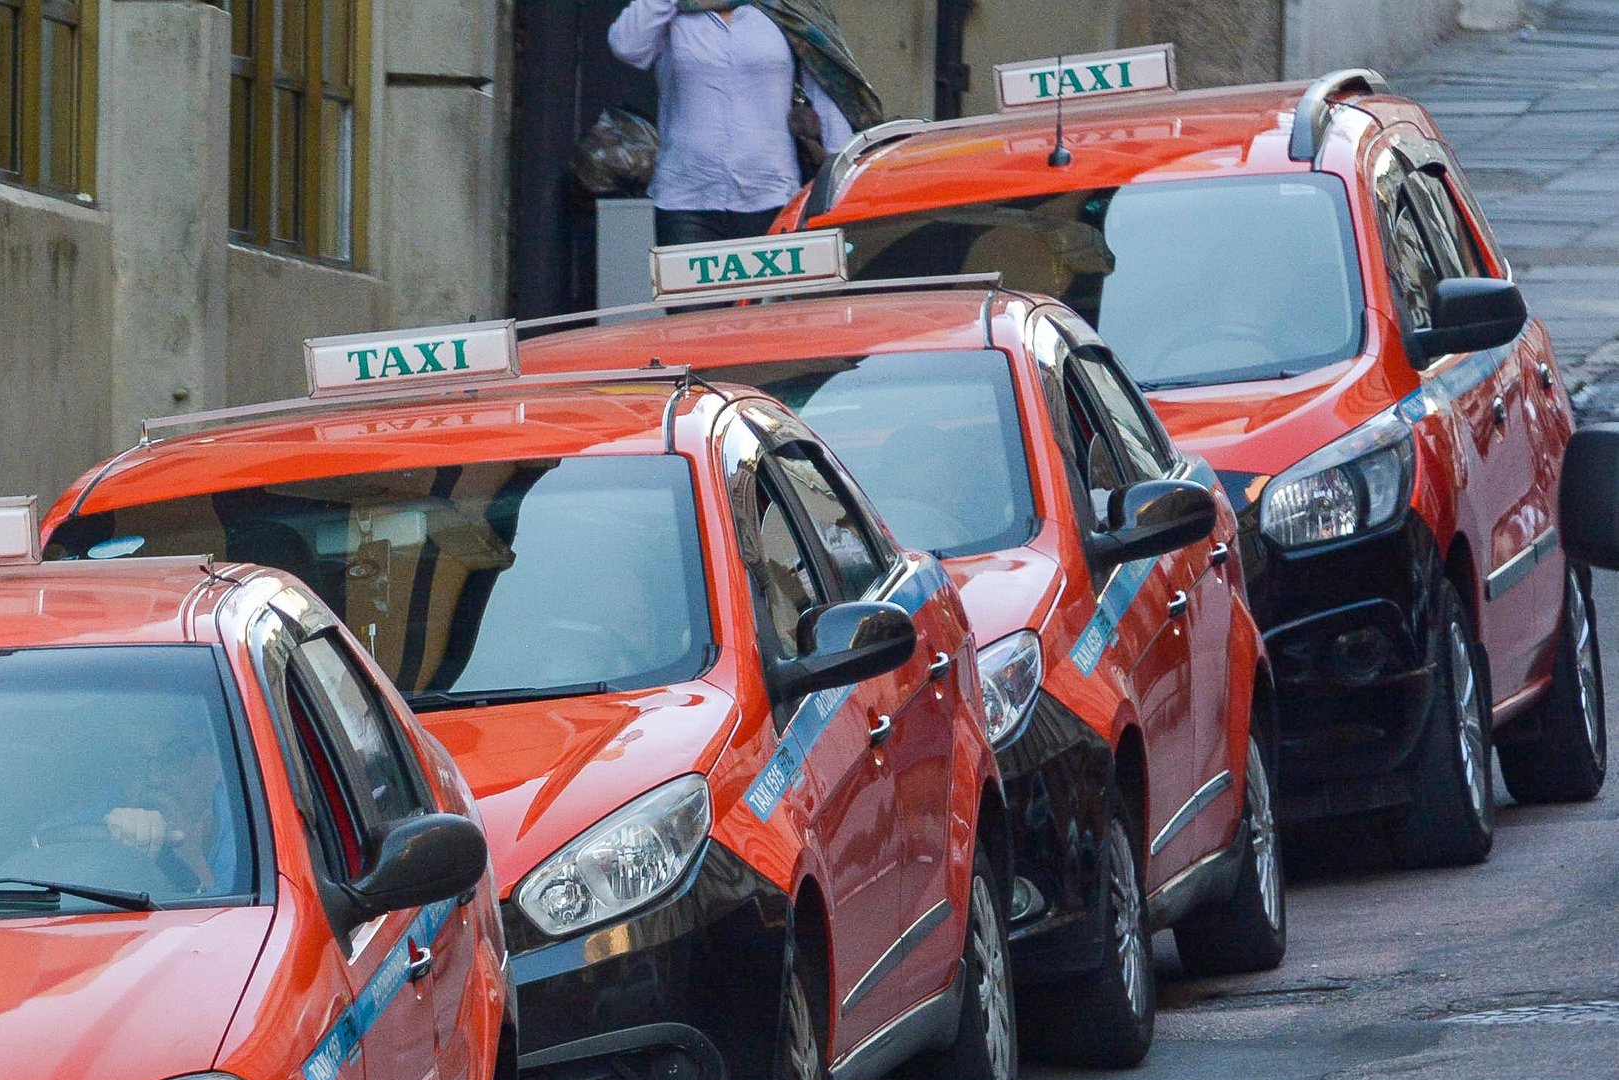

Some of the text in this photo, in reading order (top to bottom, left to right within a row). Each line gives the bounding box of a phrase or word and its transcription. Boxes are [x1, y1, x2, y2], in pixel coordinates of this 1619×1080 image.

[1030, 61, 1133, 98] TAXI
[689, 247, 805, 284] TAXI
[347, 339, 470, 381] TAXI
[1072, 643, 1094, 672] TAXI
[749, 764, 785, 813] TAXI 1515
